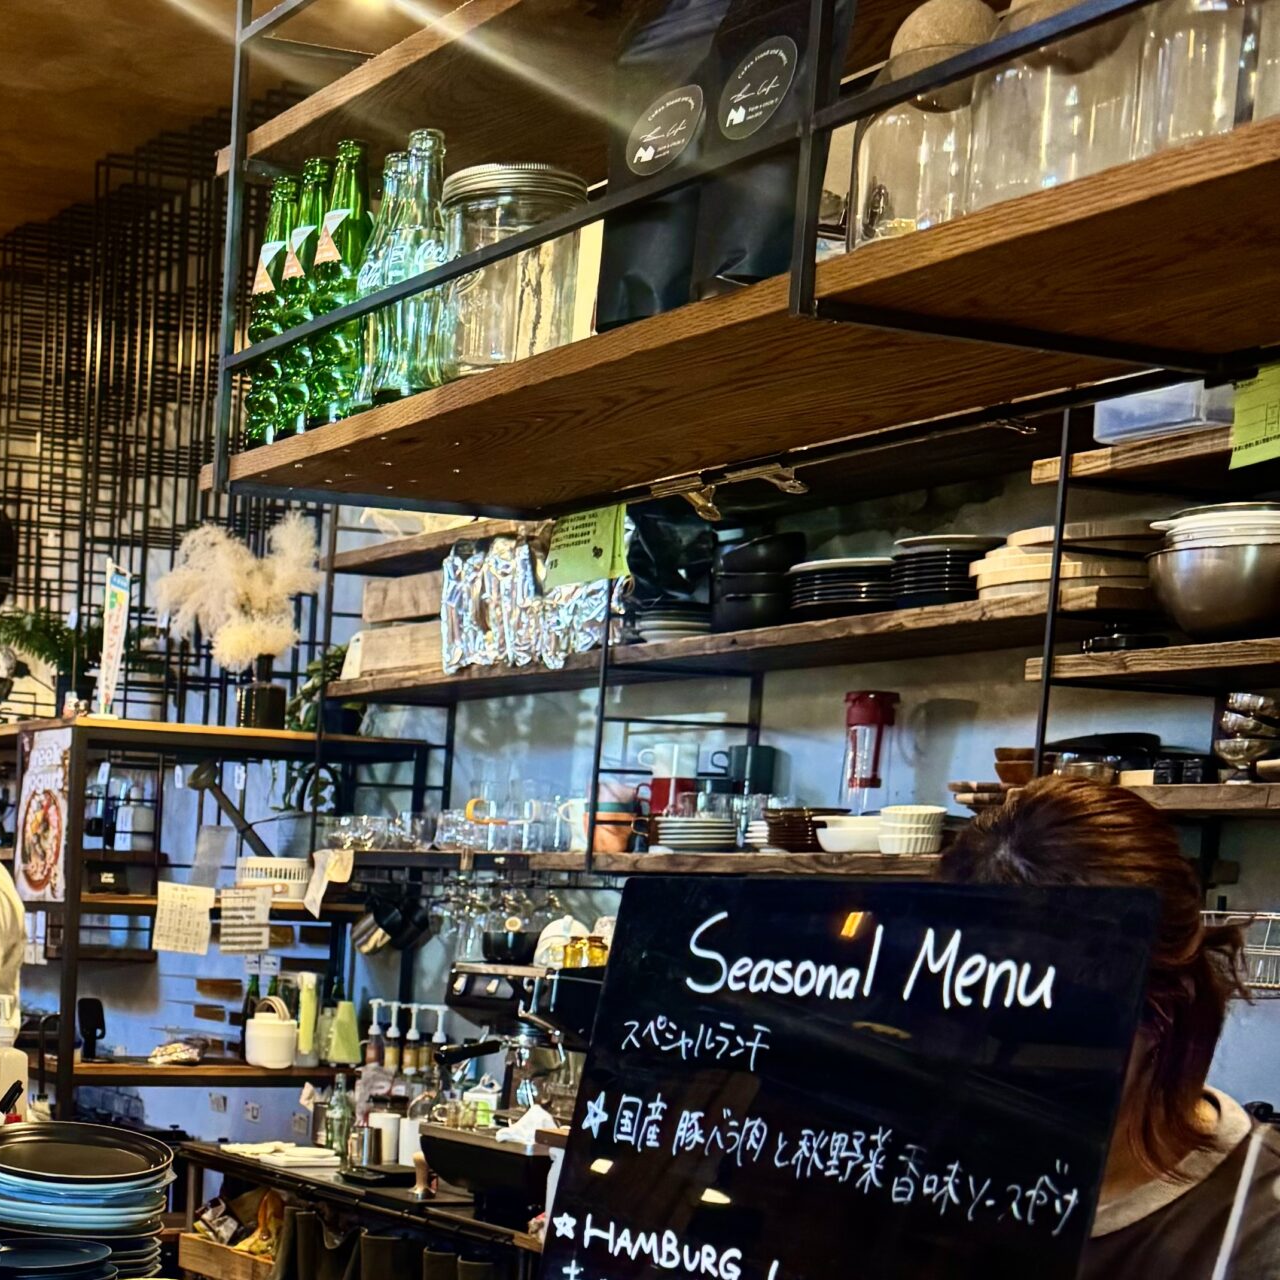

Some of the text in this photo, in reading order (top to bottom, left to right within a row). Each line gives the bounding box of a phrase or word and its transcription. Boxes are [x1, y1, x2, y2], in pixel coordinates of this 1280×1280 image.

[686, 911, 1057, 1010] Seasonal Menu
[621, 1015, 771, 1071] スペシャルランチ
